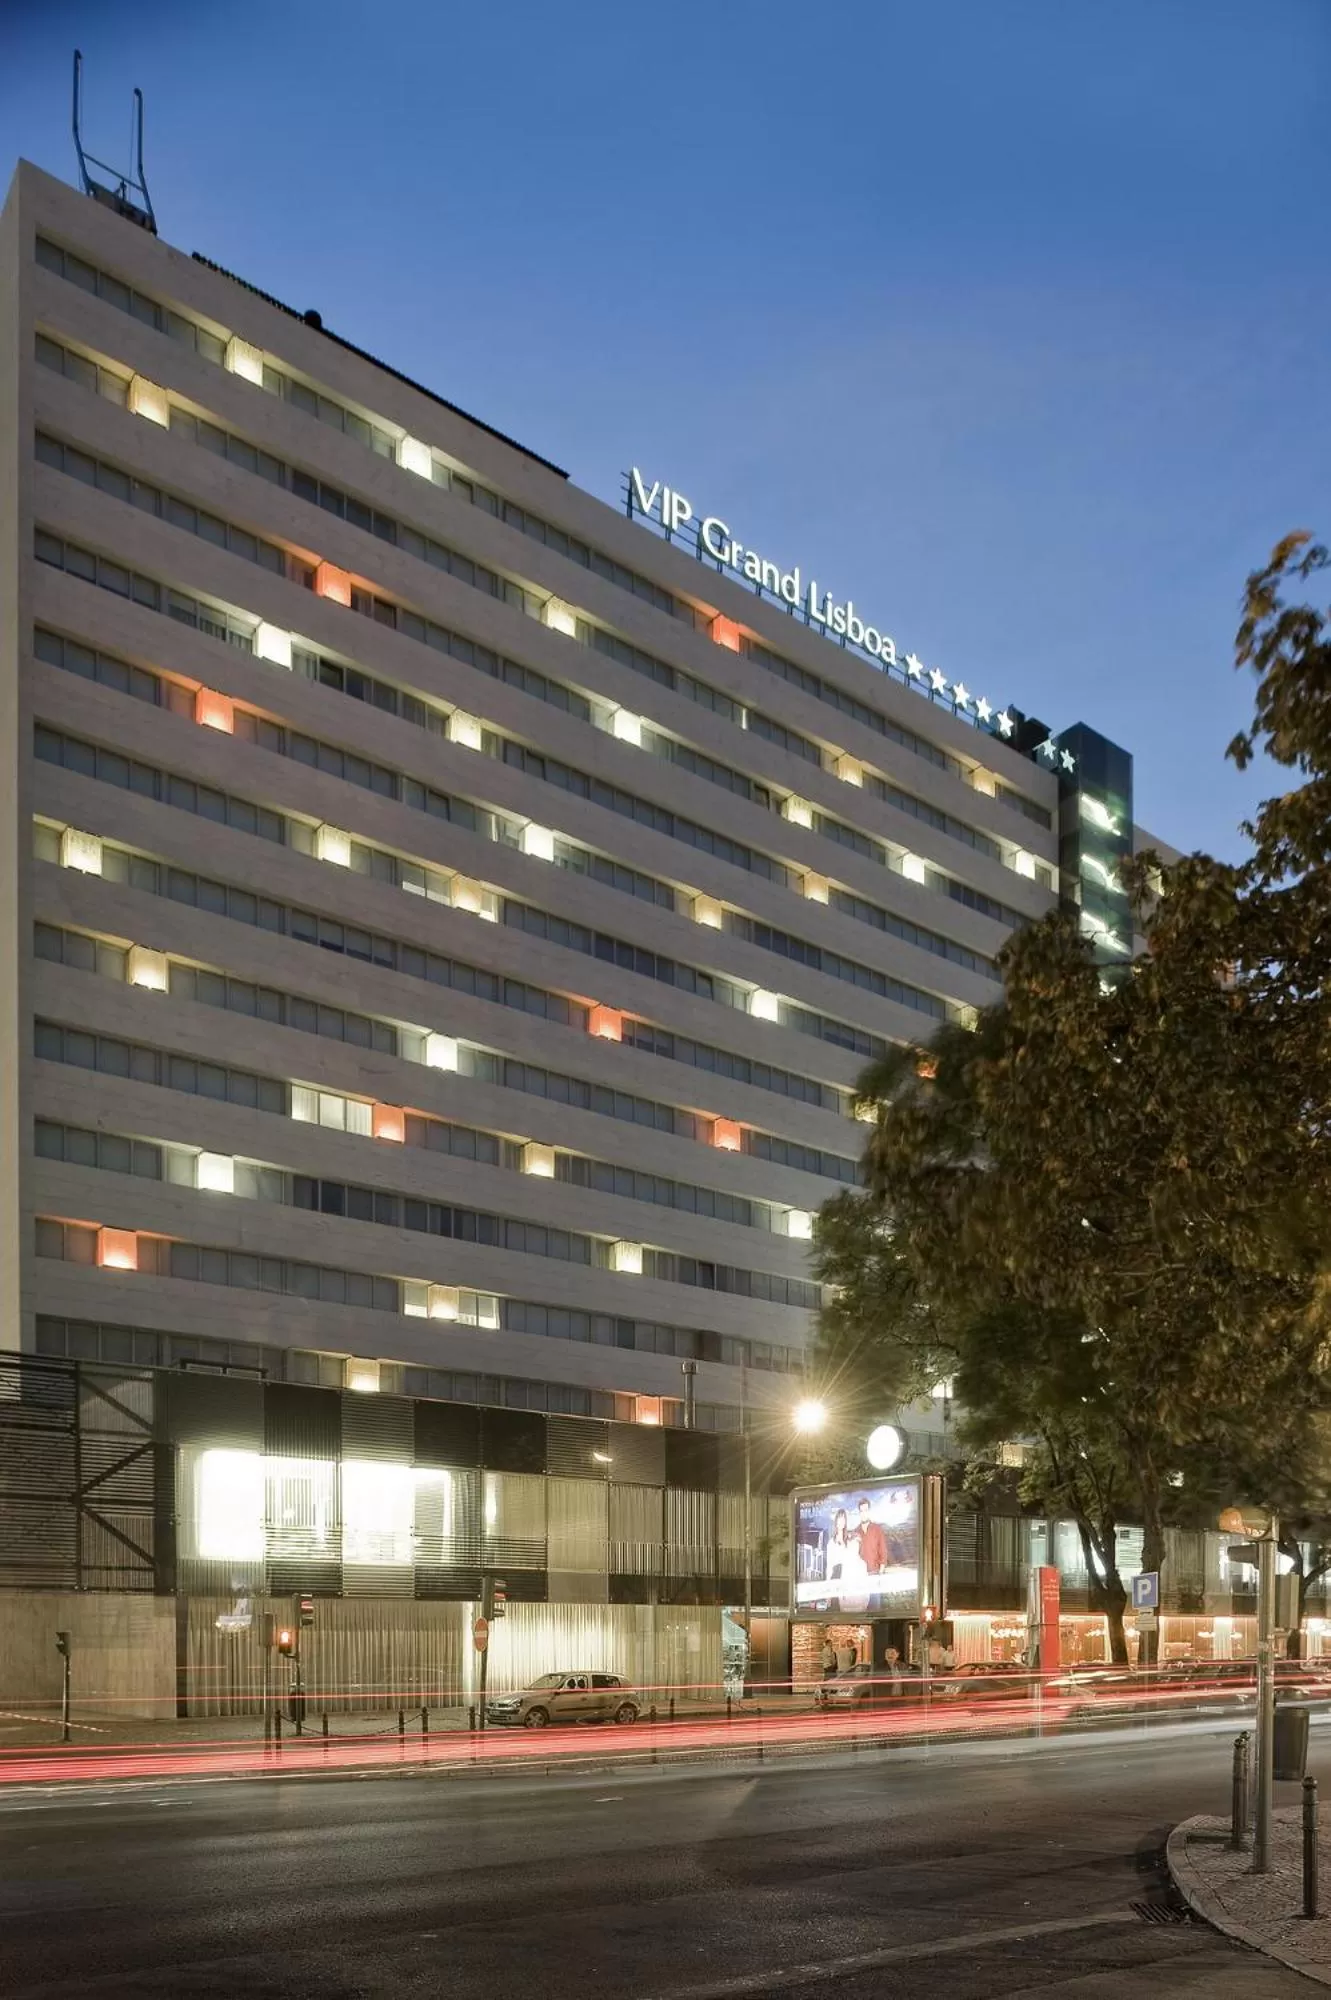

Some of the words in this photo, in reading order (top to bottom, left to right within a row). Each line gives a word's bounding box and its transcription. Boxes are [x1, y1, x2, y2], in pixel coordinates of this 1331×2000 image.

[631, 466, 693, 531] VIP
[702, 517, 801, 605] Grand
[808, 580, 897, 665] Lisboa
[1137, 1578, 1151, 1604] P
